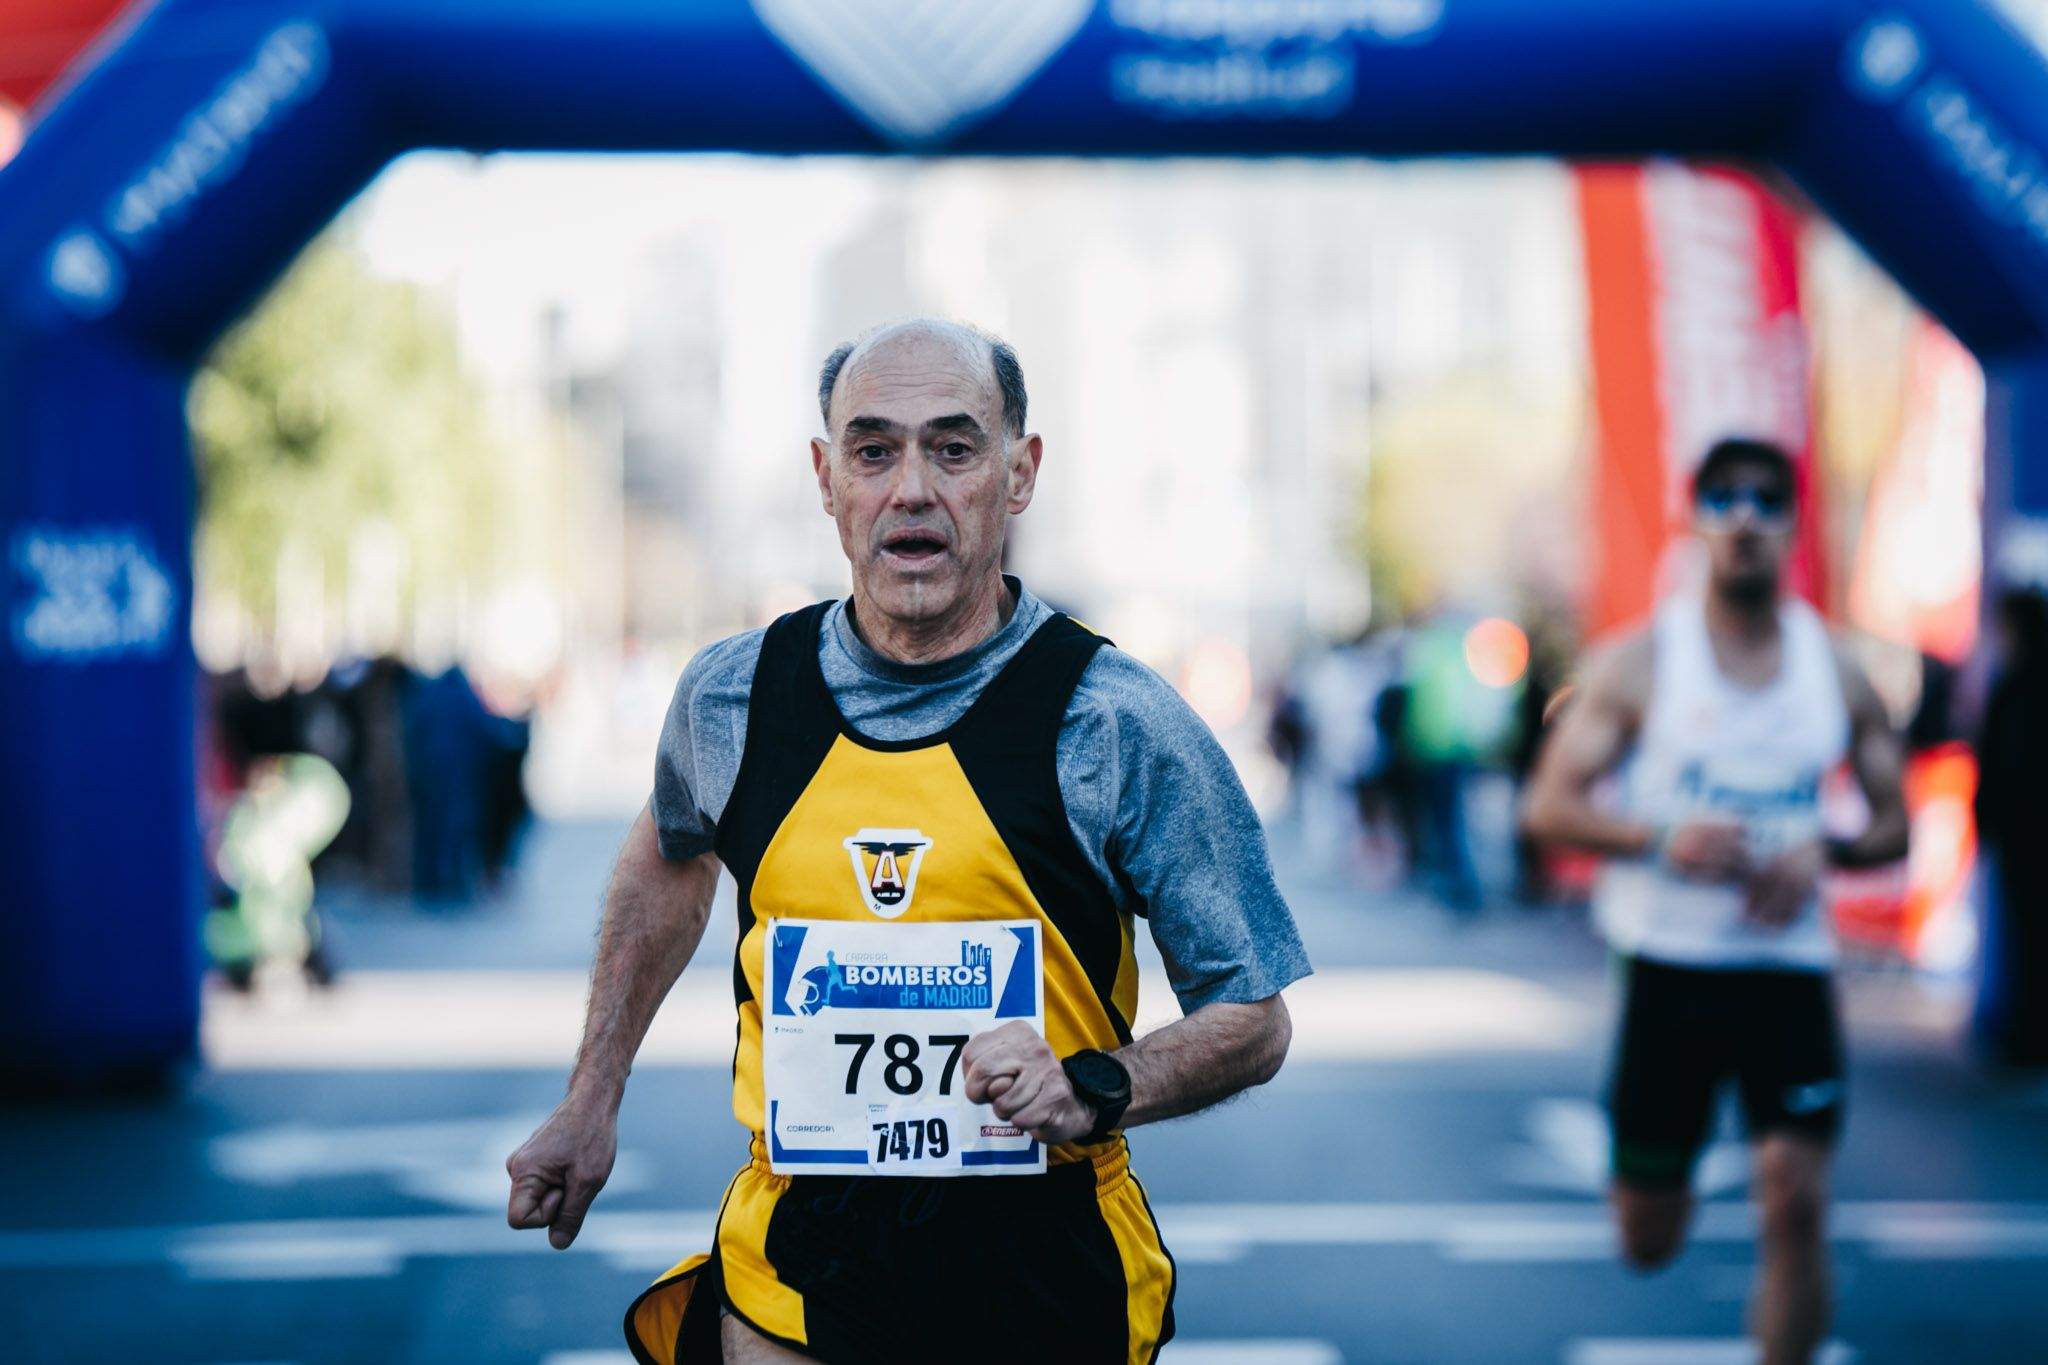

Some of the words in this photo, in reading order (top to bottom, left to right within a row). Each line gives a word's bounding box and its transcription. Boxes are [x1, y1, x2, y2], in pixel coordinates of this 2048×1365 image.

[845, 966, 988, 986] BOMBEROS
[900, 987, 919, 1006] de
[924, 986, 989, 1007] MADRID
[834, 1033, 970, 1096] 787
[872, 1118, 950, 1163] 7479
